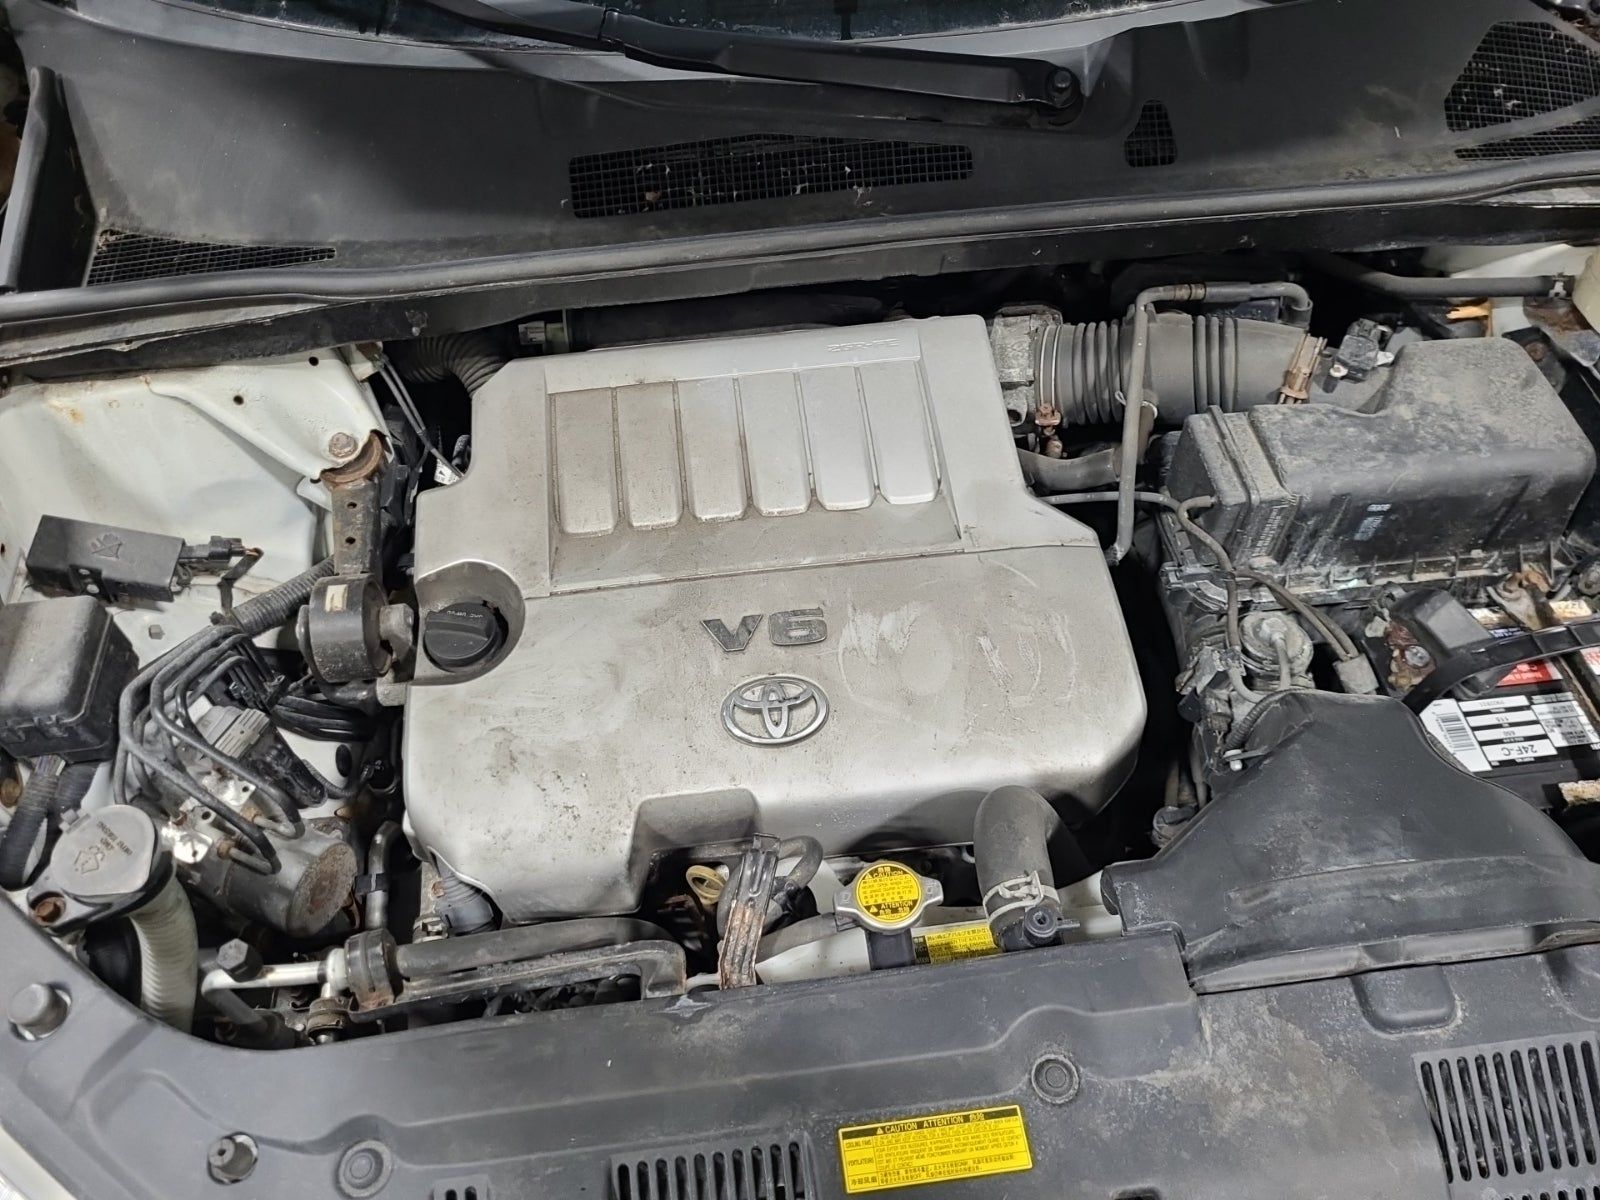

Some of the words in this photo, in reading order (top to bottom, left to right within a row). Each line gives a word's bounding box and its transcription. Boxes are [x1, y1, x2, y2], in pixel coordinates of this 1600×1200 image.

[700, 606, 828, 652] V6
[1501, 744, 1538, 757] 24F-C
[885, 1122, 918, 1134] CAUTION
[923, 1115, 963, 1128] ATTENTION
